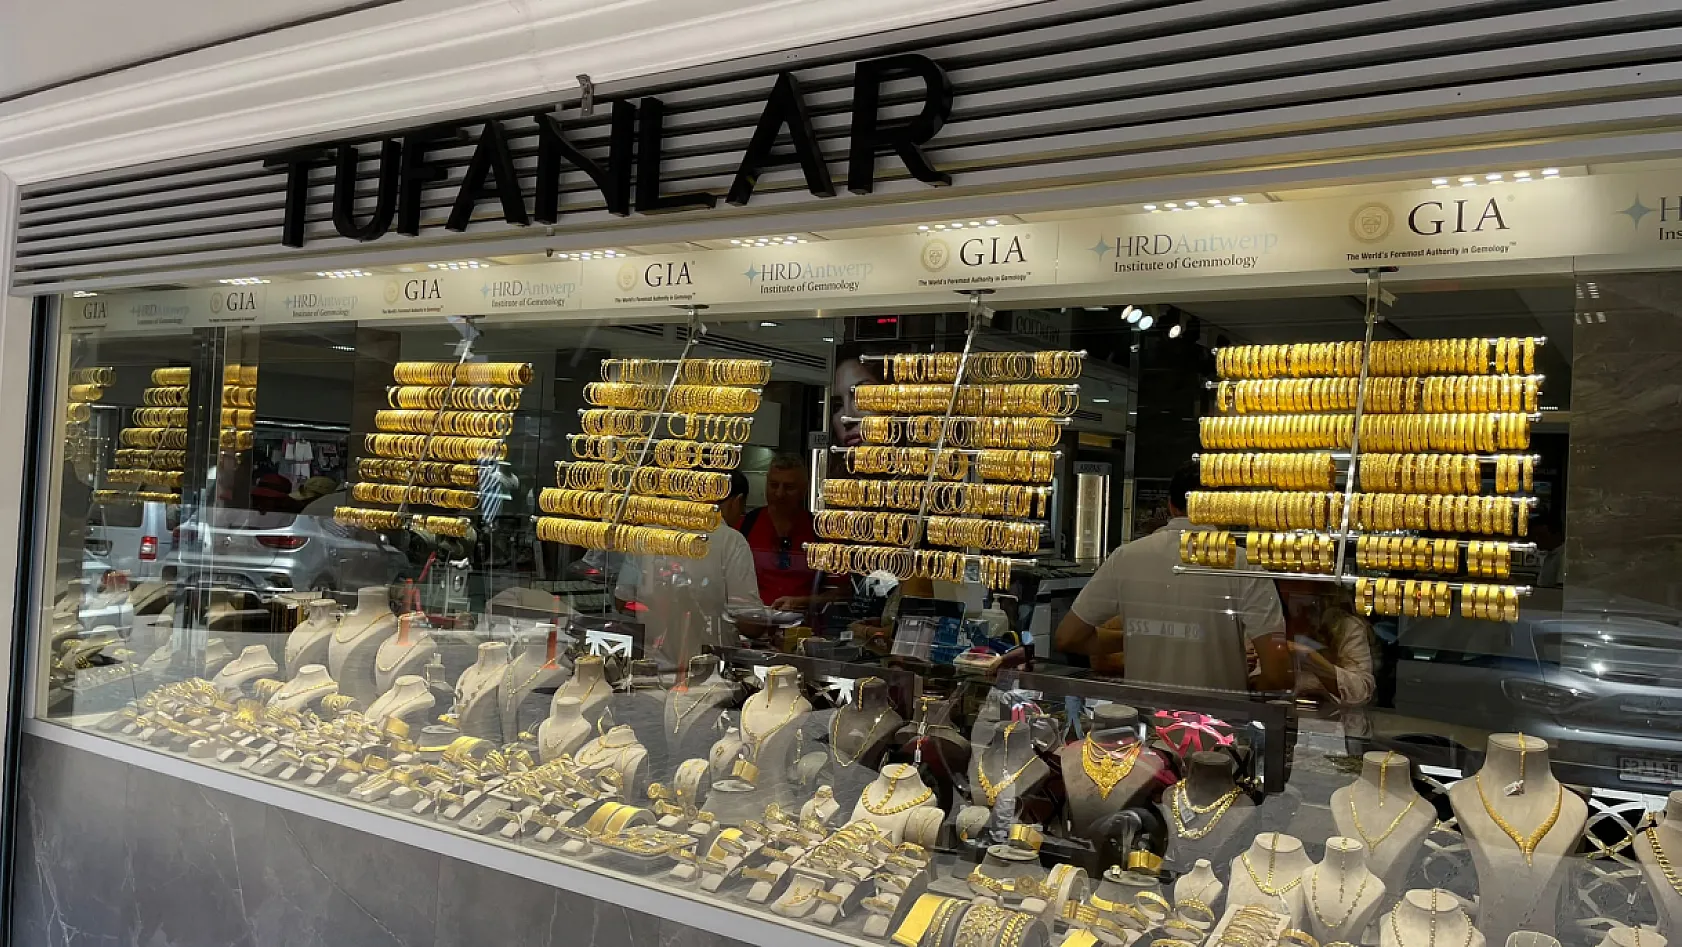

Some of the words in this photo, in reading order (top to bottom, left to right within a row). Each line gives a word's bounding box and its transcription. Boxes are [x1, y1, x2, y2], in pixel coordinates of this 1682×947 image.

[263, 54, 953, 248] TUFANLAR
[1408, 197, 1510, 236] GIA
[960, 235, 1027, 266] GIA
[1346, 253, 1360, 261] The
[1361, 251, 1389, 260] World's
[1390, 250, 1425, 258] Foremost
[1426, 247, 1460, 256] Authority
[644, 261, 693, 288] GIA
[1114, 260, 1164, 273] Institute
[1166, 257, 1180, 270] of
[1181, 253, 1259, 269] Gemmology
[404, 278, 442, 301] GIA
[760, 283, 796, 295] Institute
[796, 281, 807, 292] of
[807, 280, 860, 293] Gemmology
[226, 291, 256, 312] GIA
